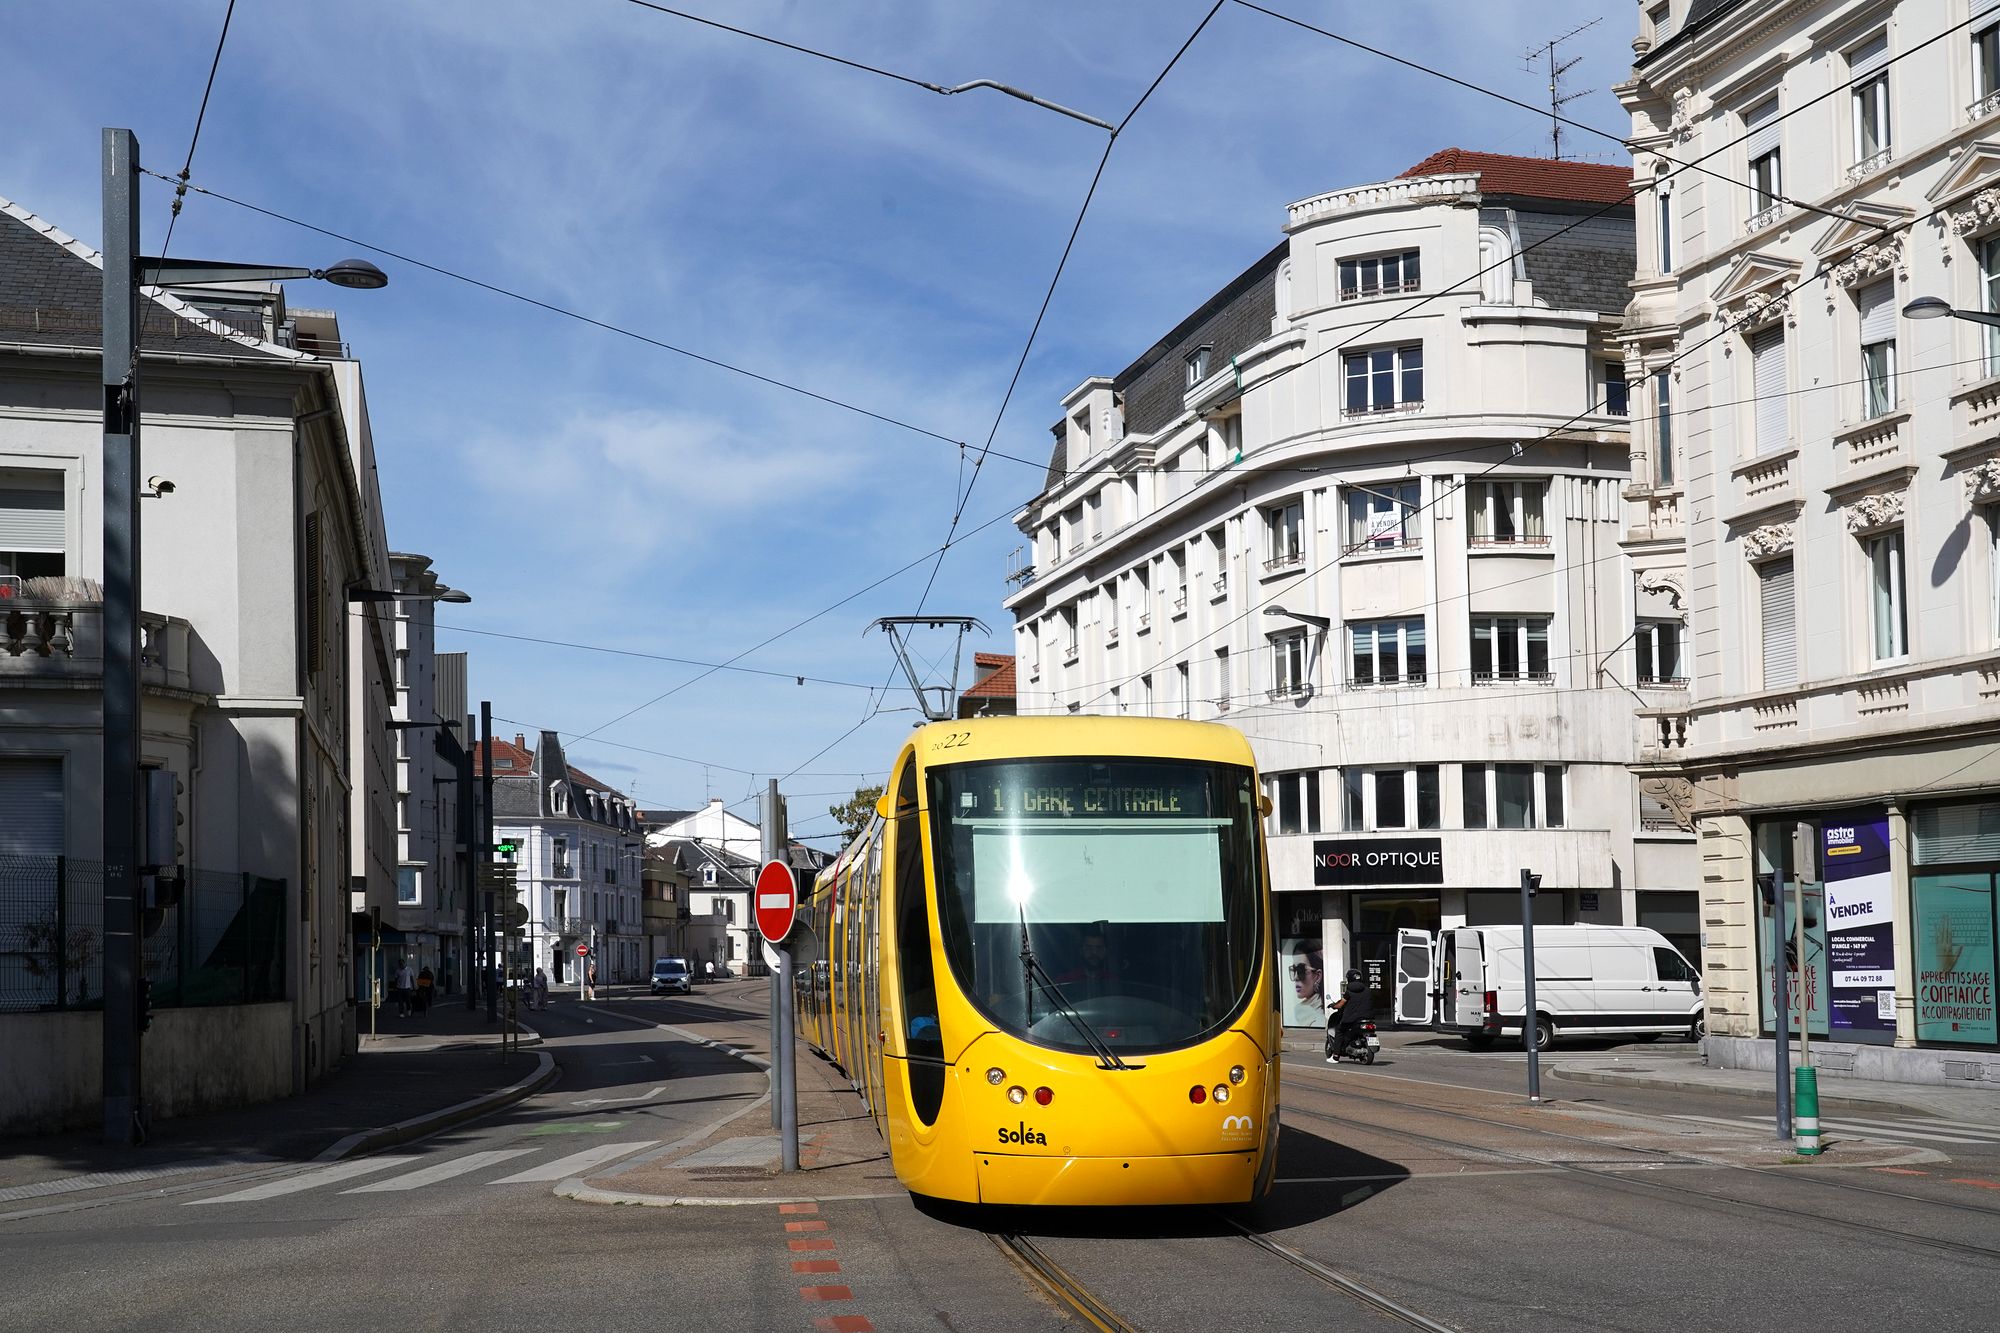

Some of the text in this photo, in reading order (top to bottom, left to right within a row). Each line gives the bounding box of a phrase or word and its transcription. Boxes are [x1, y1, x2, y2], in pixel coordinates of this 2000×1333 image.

[1023, 787, 1074, 811] GARE
[1084, 787, 1181, 811] CENTRALE
[1827, 826, 1855, 839] astra
[1315, 852, 1440, 868] NOOR OPTIQUE
[1829, 892, 1836, 905] À
[1830, 901, 1873, 919] VENDRE
[1921, 971, 1991, 985] APPRENTISSAGE
[1921, 985, 1991, 1004] CONFIANCE
[1922, 1005, 1992, 1021] ACCOMPAGNEMENT
[998, 1121, 1047, 1146] Soléa
